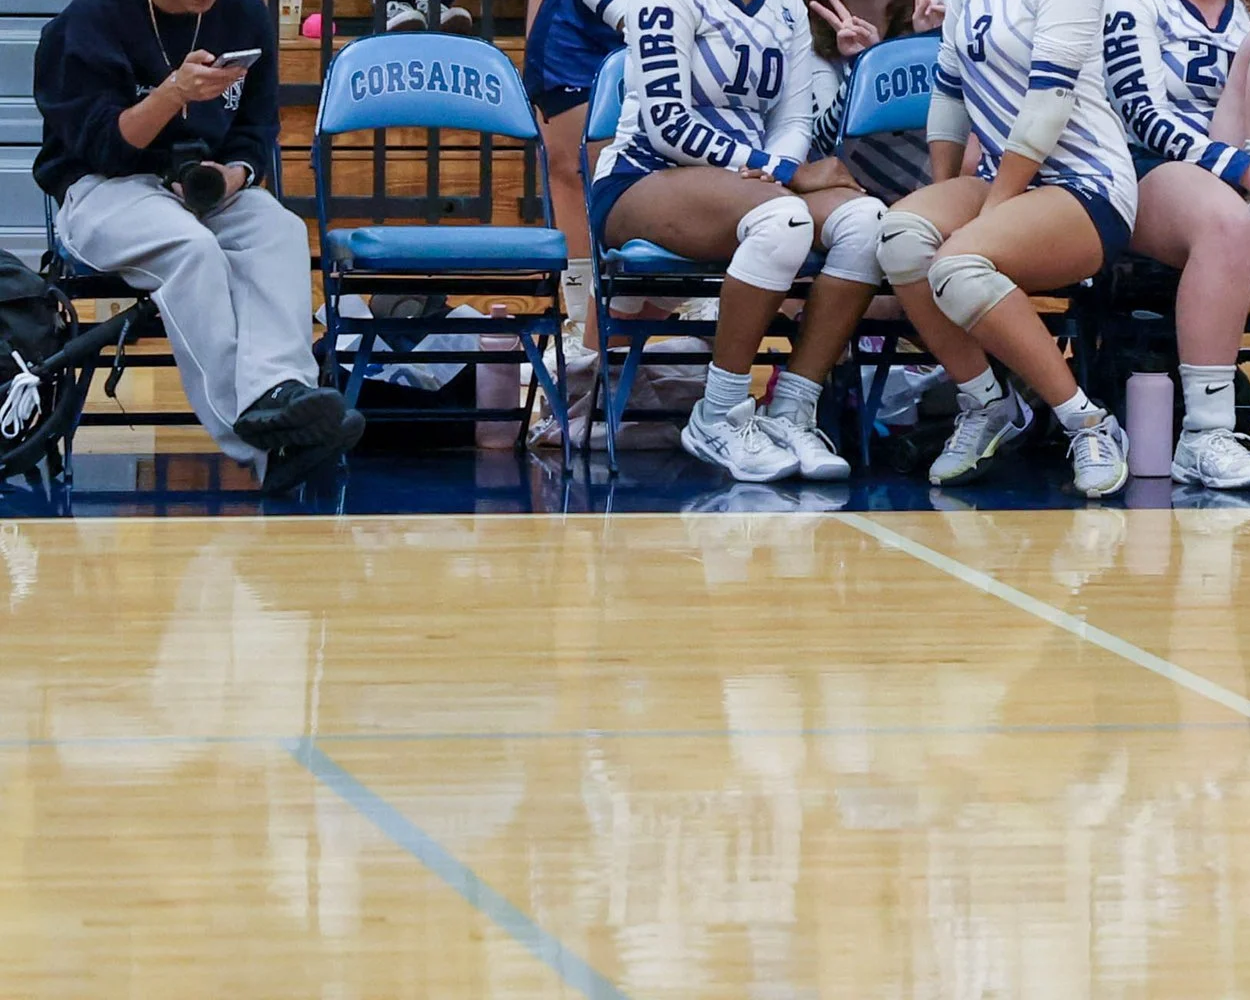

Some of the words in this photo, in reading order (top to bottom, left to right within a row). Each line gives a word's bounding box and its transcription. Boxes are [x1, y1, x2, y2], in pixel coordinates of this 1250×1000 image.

[967, 14, 993, 62] 3
[1186, 40, 1236, 87] 2
[350, 60, 501, 106] CORSAIRS
[639, 6, 738, 167] CORSAIRS
[723, 44, 784, 99] 10
[1103, 11, 1195, 161] CORSAIRS
